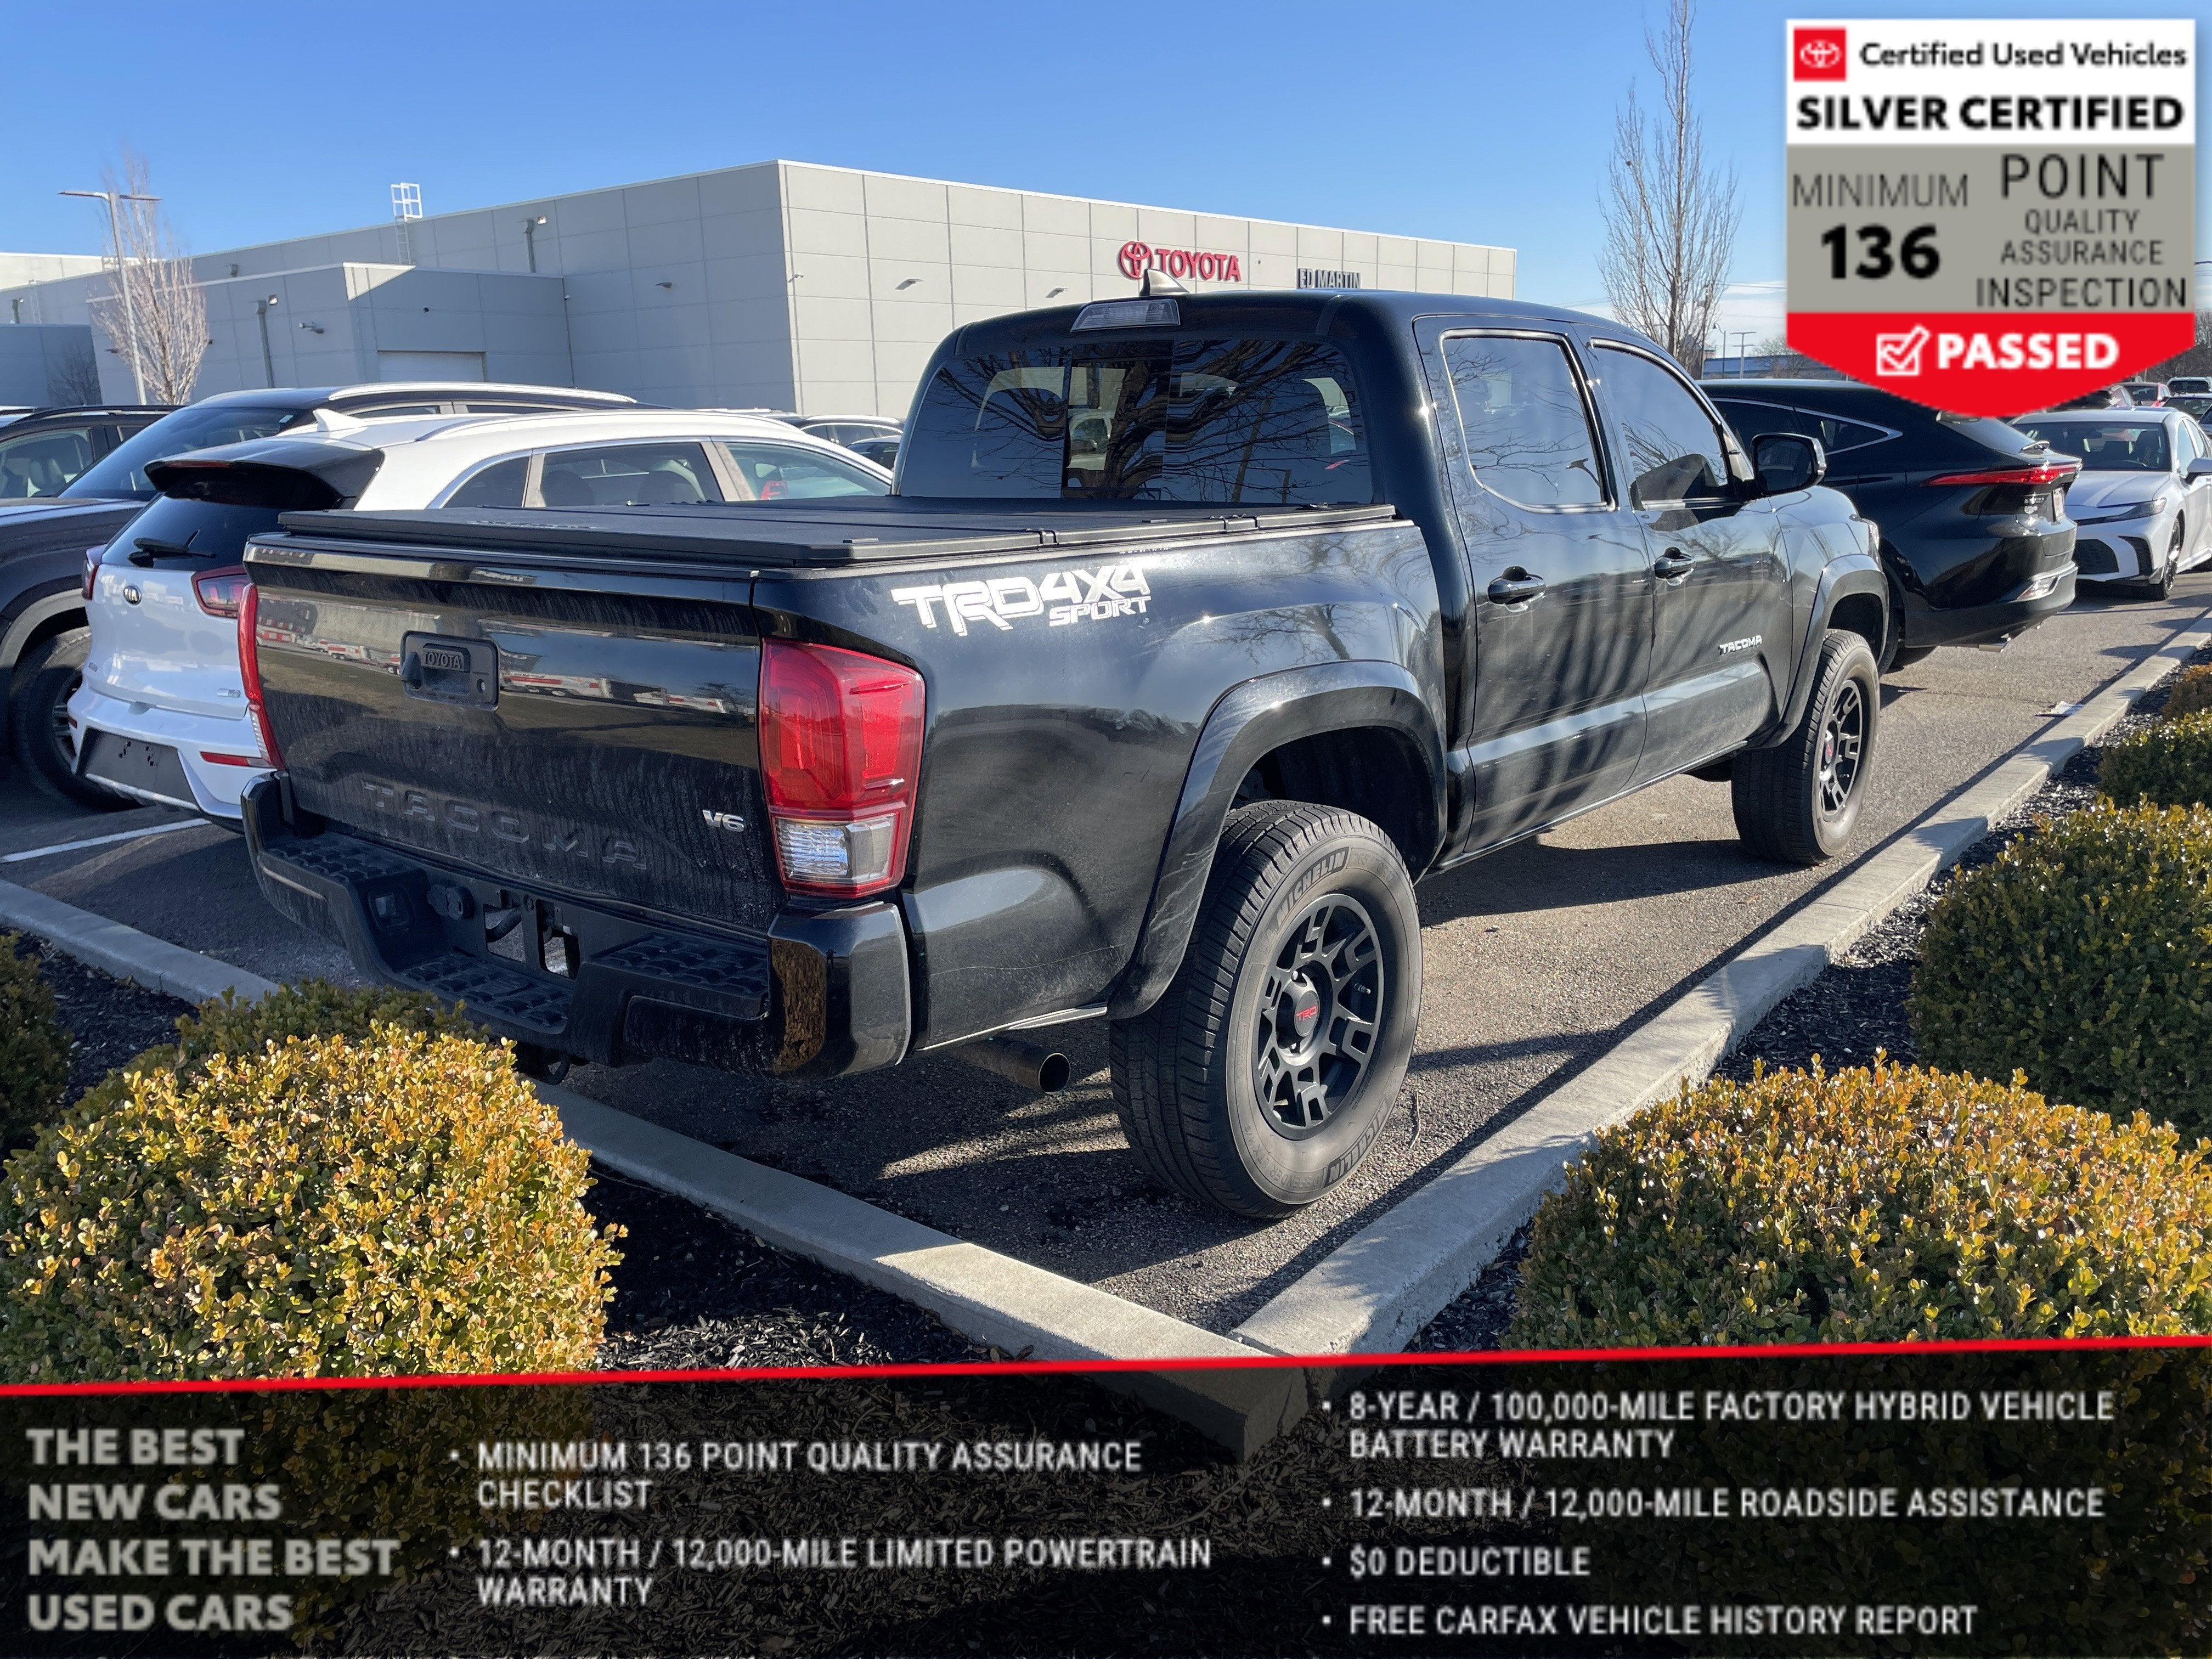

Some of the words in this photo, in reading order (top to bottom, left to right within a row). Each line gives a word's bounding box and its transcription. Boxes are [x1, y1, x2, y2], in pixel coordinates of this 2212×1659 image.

[1155, 249, 1242, 282] TOYOTA
[1297, 268, 1313, 289] ED
[1315, 269, 1361, 289] MARTIN
[891, 576, 1044, 636] TRD
[1049, 595, 1152, 627] SPORT
[1718, 635, 1763, 655] TACOMA
[423, 651, 462, 669] TOYOTA
[702, 809, 745, 832] V6
[1277, 850, 1346, 929] MICHELIN
[1296, 1005, 1317, 1021] TRD
[1328, 1101, 1388, 1183] MICHELIN
